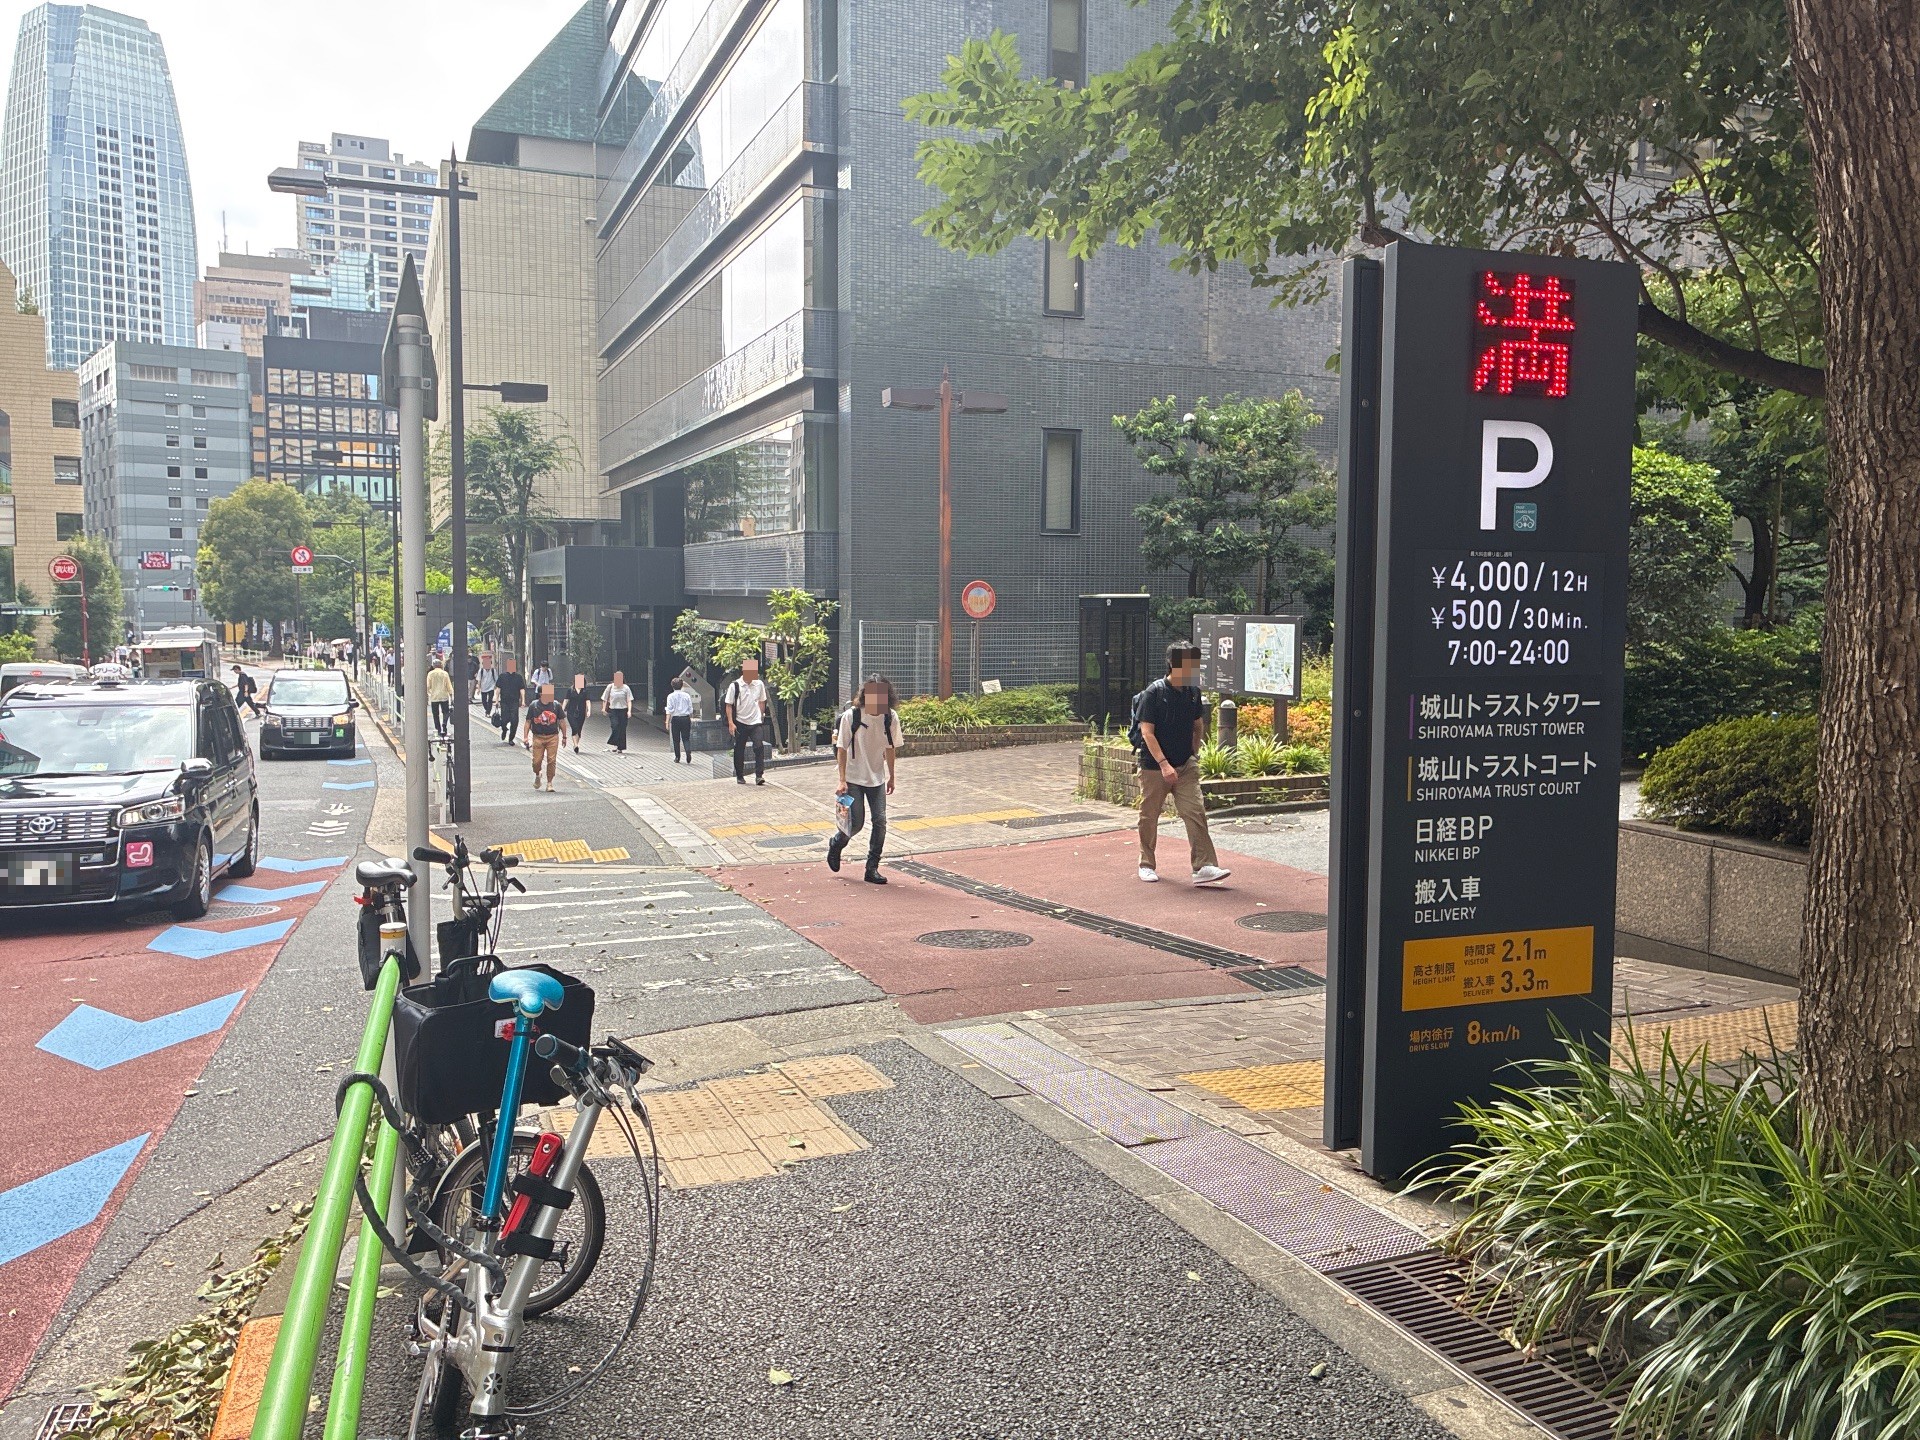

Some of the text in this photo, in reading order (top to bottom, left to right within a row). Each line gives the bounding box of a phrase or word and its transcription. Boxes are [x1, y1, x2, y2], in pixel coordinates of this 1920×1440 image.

[1474, 271, 1576, 398] 満
[1480, 419, 1554, 531] P
[1448, 639, 1570, 666] 7:00-24:00
[1419, 691, 1601, 720] 城山トラストタワー
[1418, 721, 1585, 740] SHIROYAMA TRUST TOWER
[1417, 751, 1597, 782] 城山トラストコート
[1416, 781, 1582, 802] SHIROYAMA TRUST COURT
[1416, 815, 1494, 844] 日経BP
[1414, 846, 1481, 863] NIKKEI BP
[1414, 875, 1481, 905] 搬入車
[1414, 906, 1477, 924] DELIVERY
[1464, 943, 1497, 958] 時間貸
[1413, 962, 1456, 977] 高さ制限
[1463, 957, 1489, 966] VISITOR
[1412, 975, 1456, 986] HEIGHT LIMIT
[1463, 974, 1496, 989] 搬入車
[1462, 988, 1494, 998] DELIVERY
[1409, 1019, 1520, 1046] 場内徐行 8km/h
[1408, 1041, 1450, 1053] DRIVE SLOW
